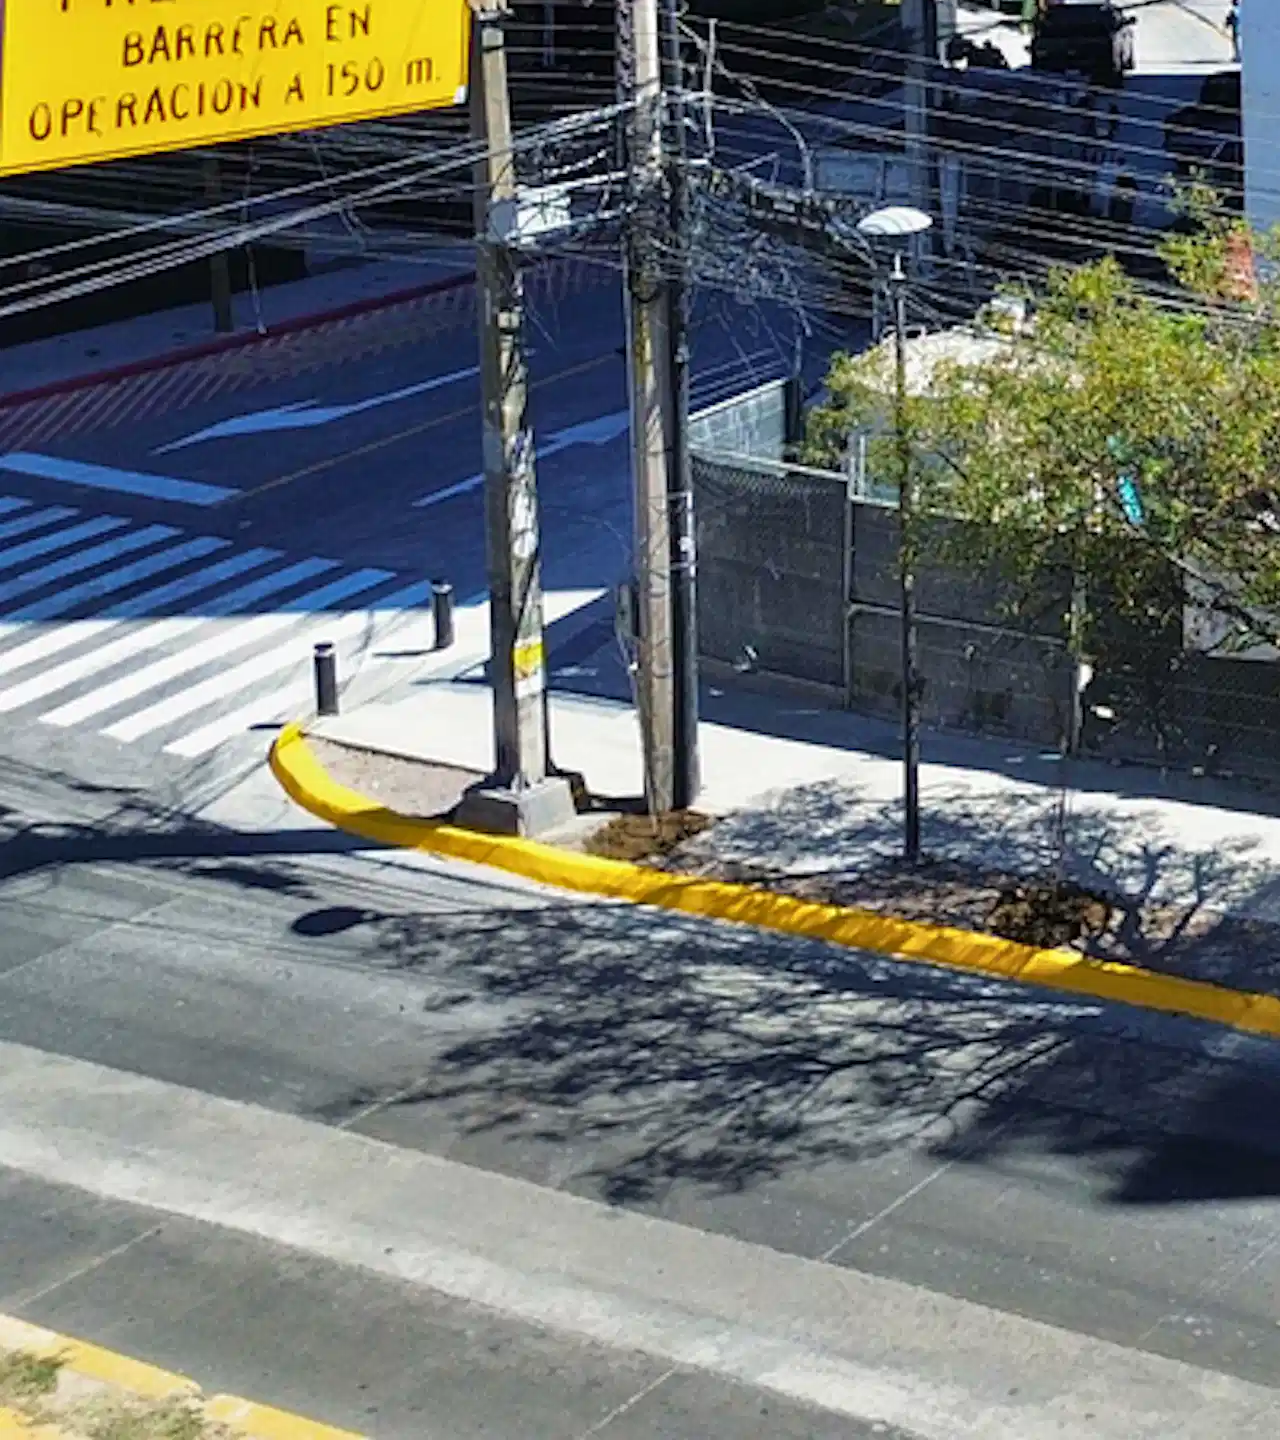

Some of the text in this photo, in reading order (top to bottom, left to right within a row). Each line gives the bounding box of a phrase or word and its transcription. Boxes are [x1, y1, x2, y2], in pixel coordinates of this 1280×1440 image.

[122, 4, 372, 68] BARRERA EN
[28, 75, 263, 142] OPERACION
[283, 72, 305, 104] A
[326, 55, 385, 98] 150
